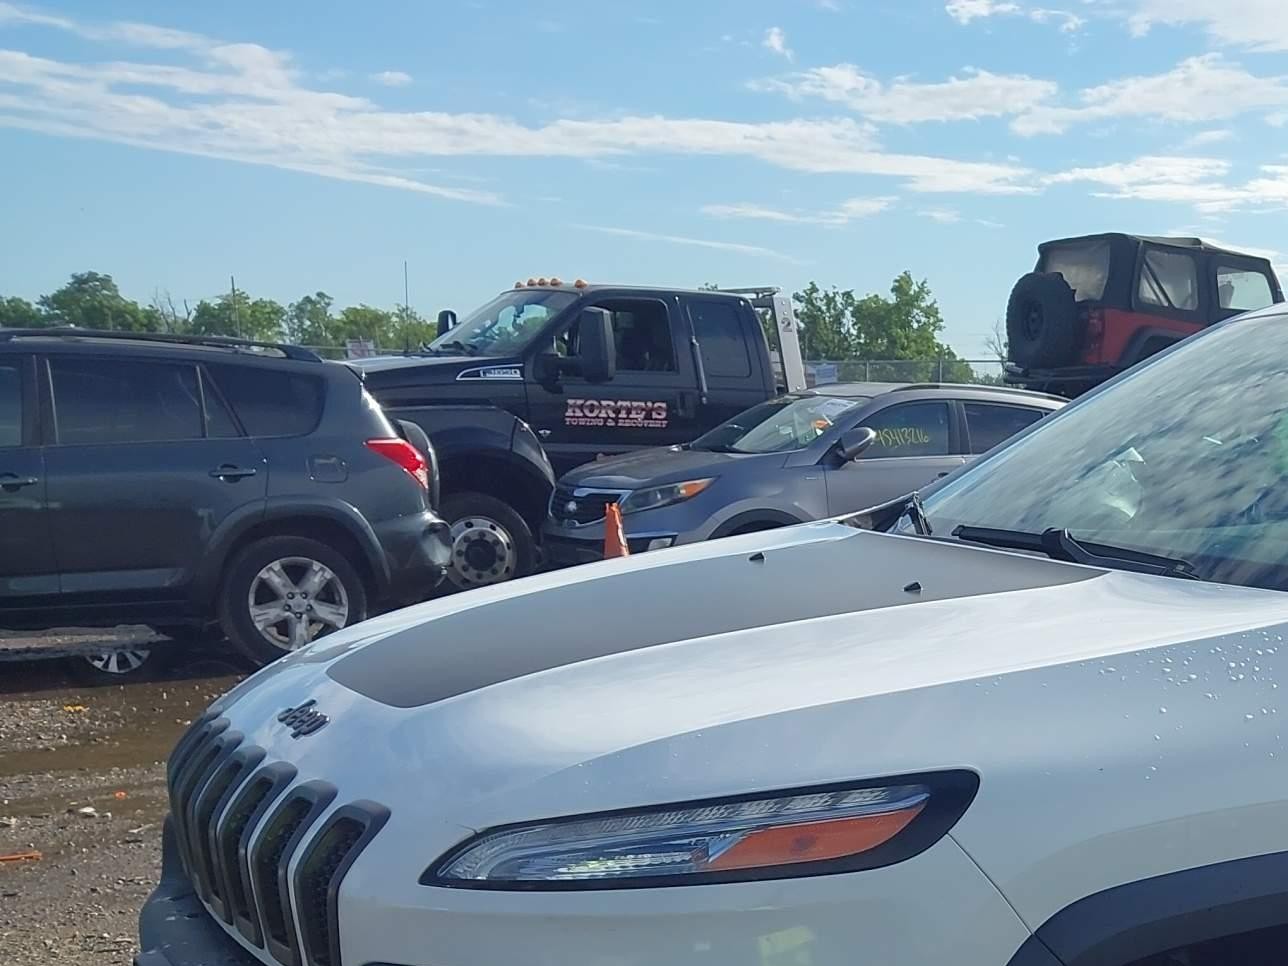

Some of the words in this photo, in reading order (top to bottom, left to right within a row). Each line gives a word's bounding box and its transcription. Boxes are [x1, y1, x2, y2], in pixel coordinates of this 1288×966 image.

[565, 399, 667, 419] KORTE'S
[565, 417, 604, 427] TOWING
[606, 419, 616, 427] &
[617, 419, 668, 429] RECOVERY
